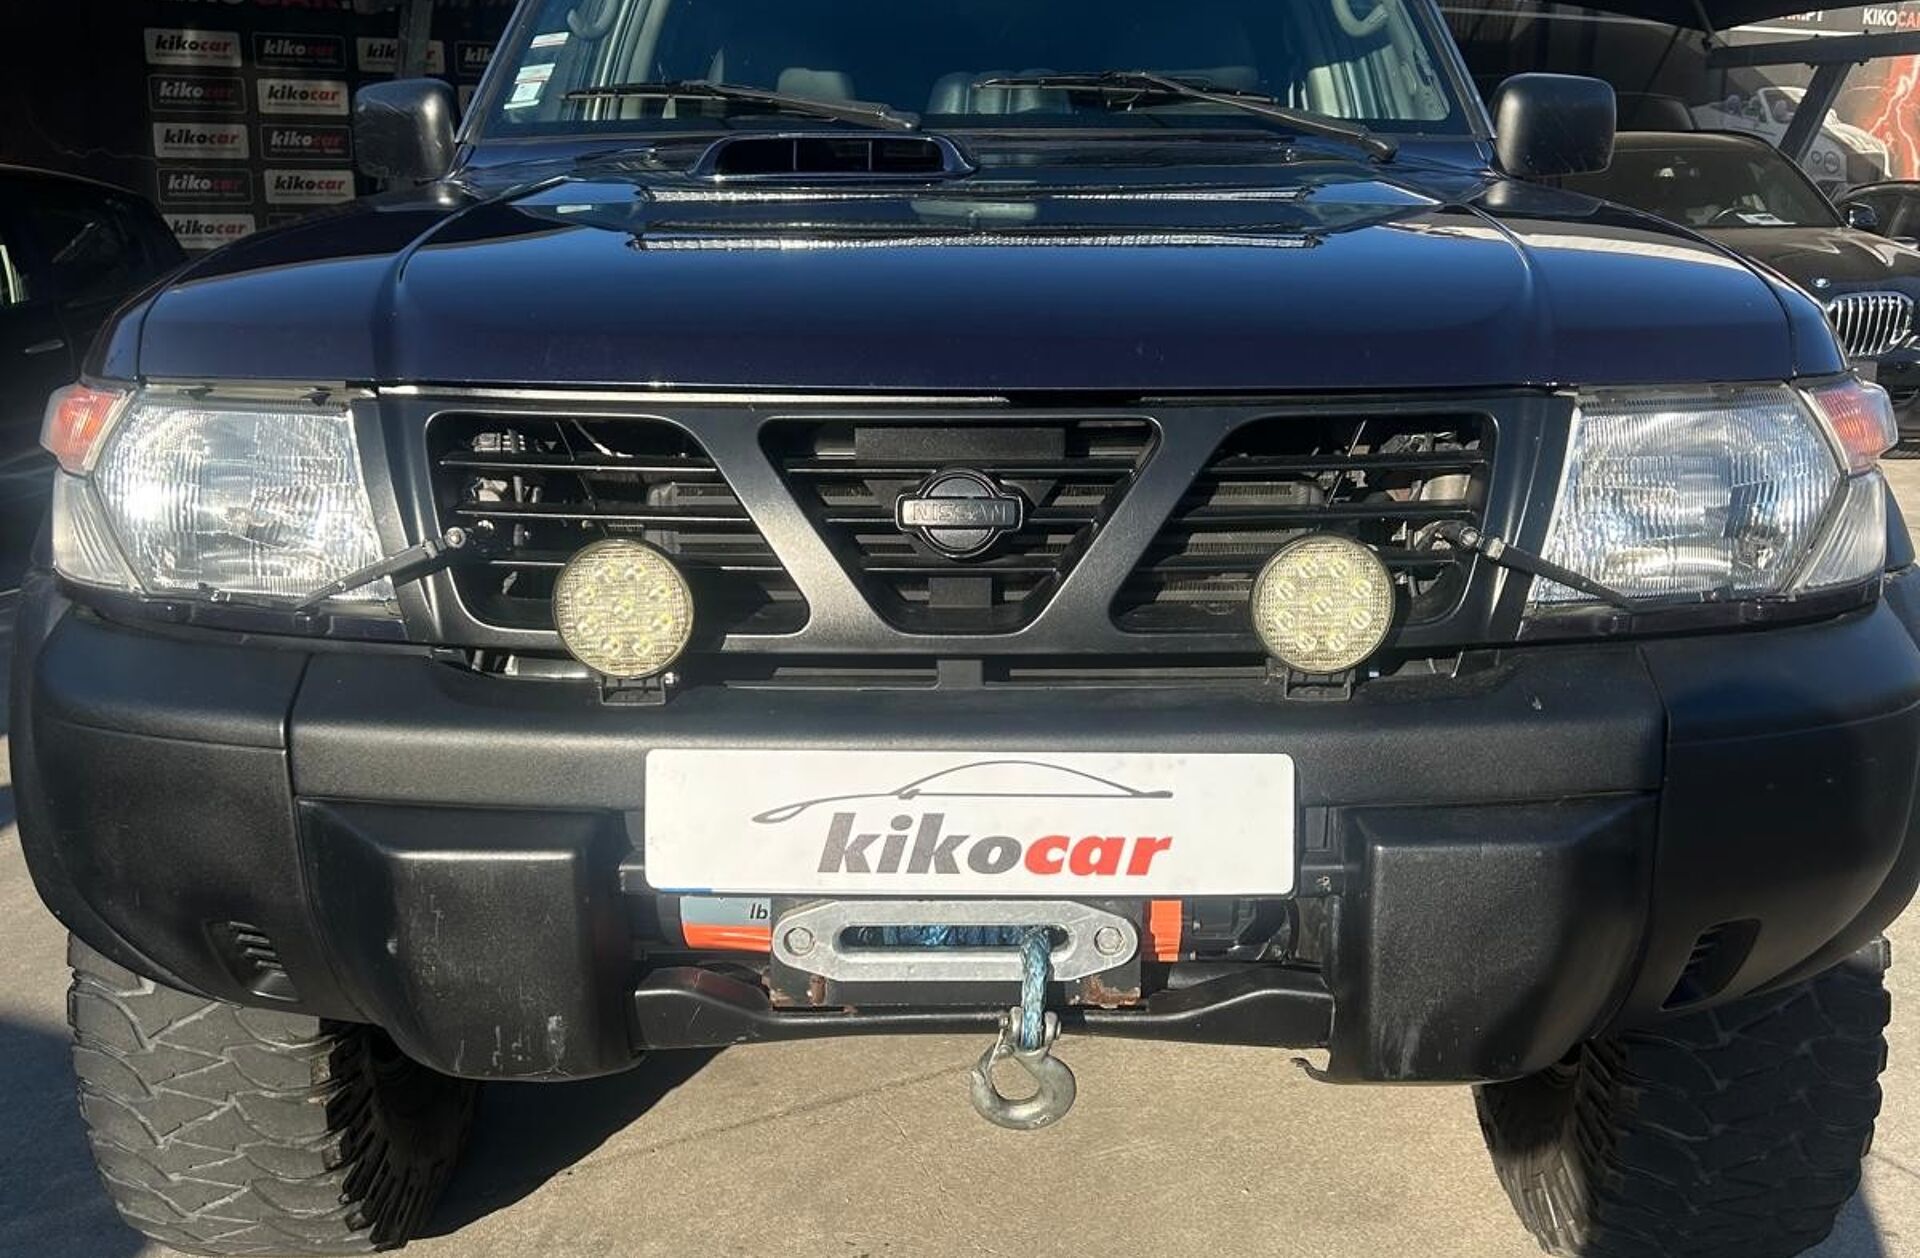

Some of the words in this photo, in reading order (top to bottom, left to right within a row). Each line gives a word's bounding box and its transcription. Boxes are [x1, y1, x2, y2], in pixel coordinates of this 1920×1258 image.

[156, 35, 232, 51] kikocar
[264, 40, 336, 56] kikocar
[159, 81, 233, 98] kikocar
[268, 85, 340, 101] kikocar
[164, 129, 239, 145] kikocar
[271, 131, 345, 147] kikocar
[169, 174, 241, 190] kikocar
[275, 176, 345, 190] kikocar
[173, 220, 246, 235] kikocar
[911, 502, 1007, 522] NISSAN
[817, 812, 1172, 876] kikocar
